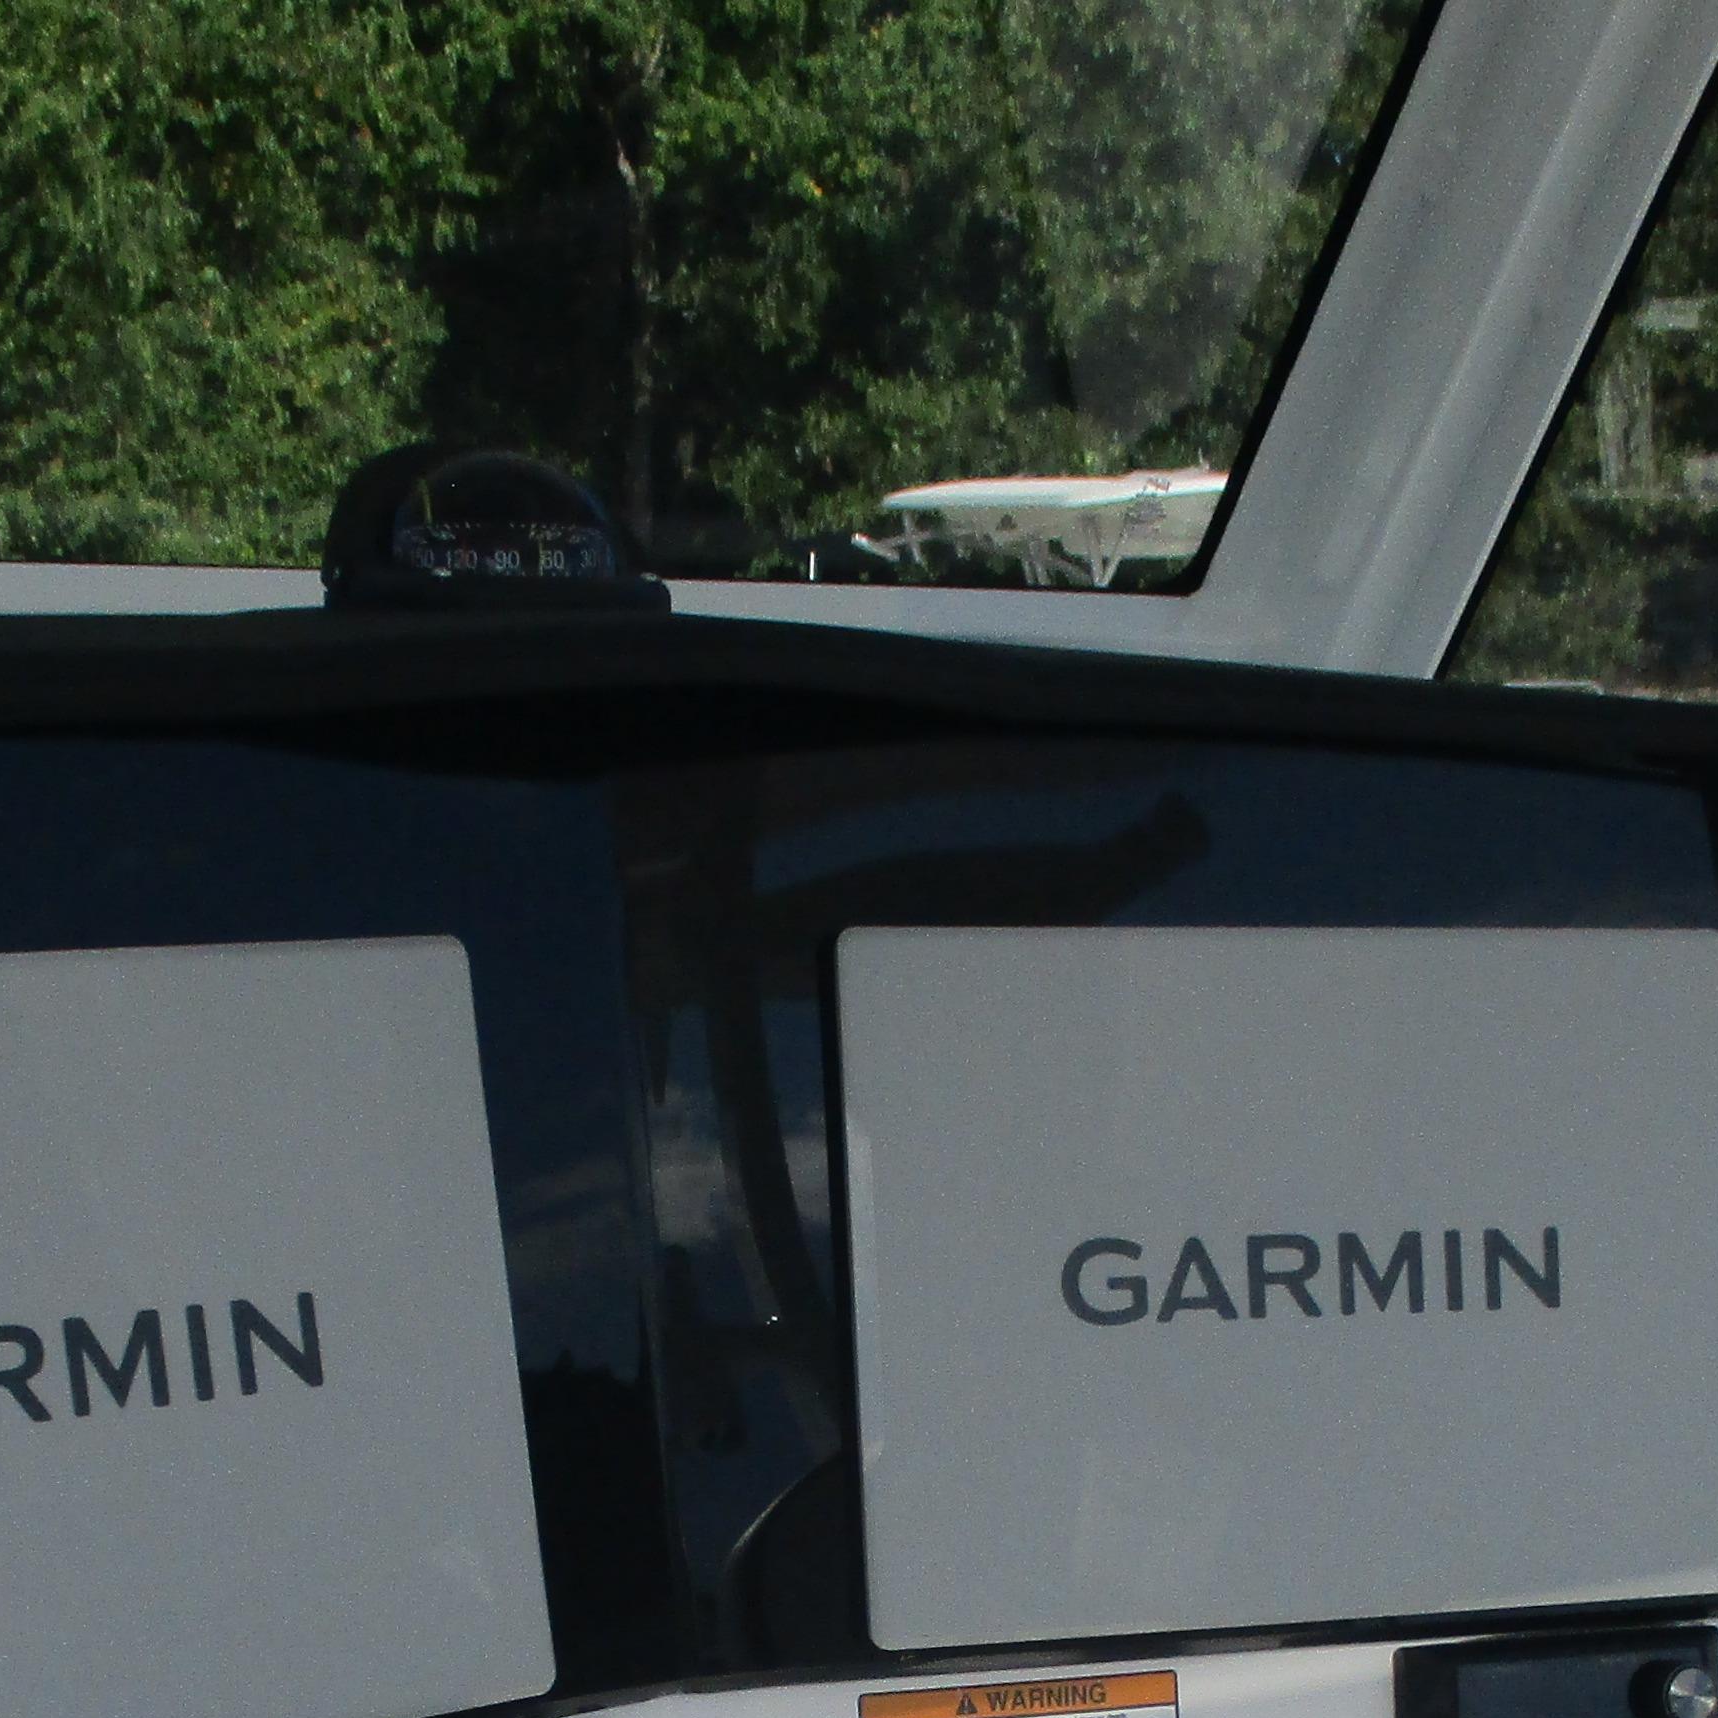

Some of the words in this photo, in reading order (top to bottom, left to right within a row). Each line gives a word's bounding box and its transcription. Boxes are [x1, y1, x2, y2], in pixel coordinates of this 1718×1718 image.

[492, 548, 521, 571] 90
[1060, 1225, 1561, 1327] GARMIN
[986, 1683, 1107, 1712] WARNING
